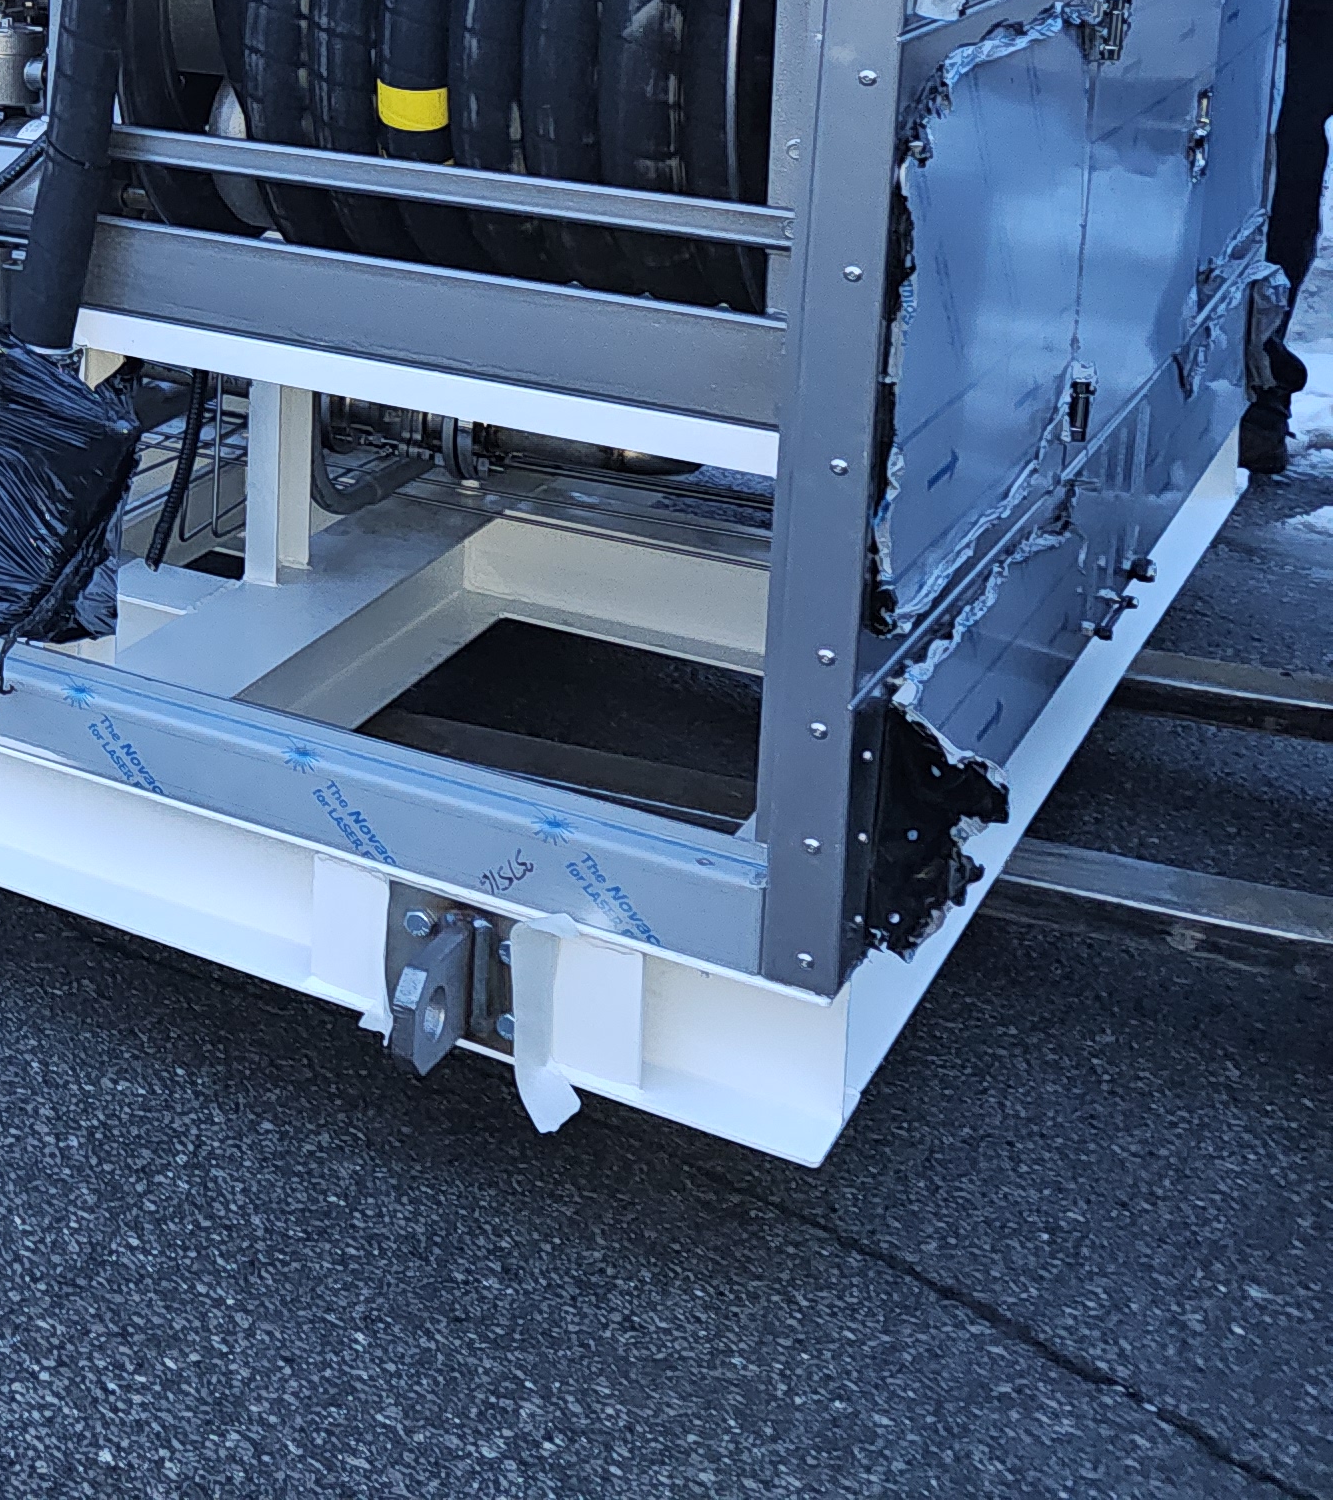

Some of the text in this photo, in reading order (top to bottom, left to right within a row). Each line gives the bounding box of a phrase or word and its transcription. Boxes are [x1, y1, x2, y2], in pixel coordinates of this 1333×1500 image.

[326, 780, 349, 808] The
[565, 861, 587, 883] for
[580, 851, 607, 884] The
